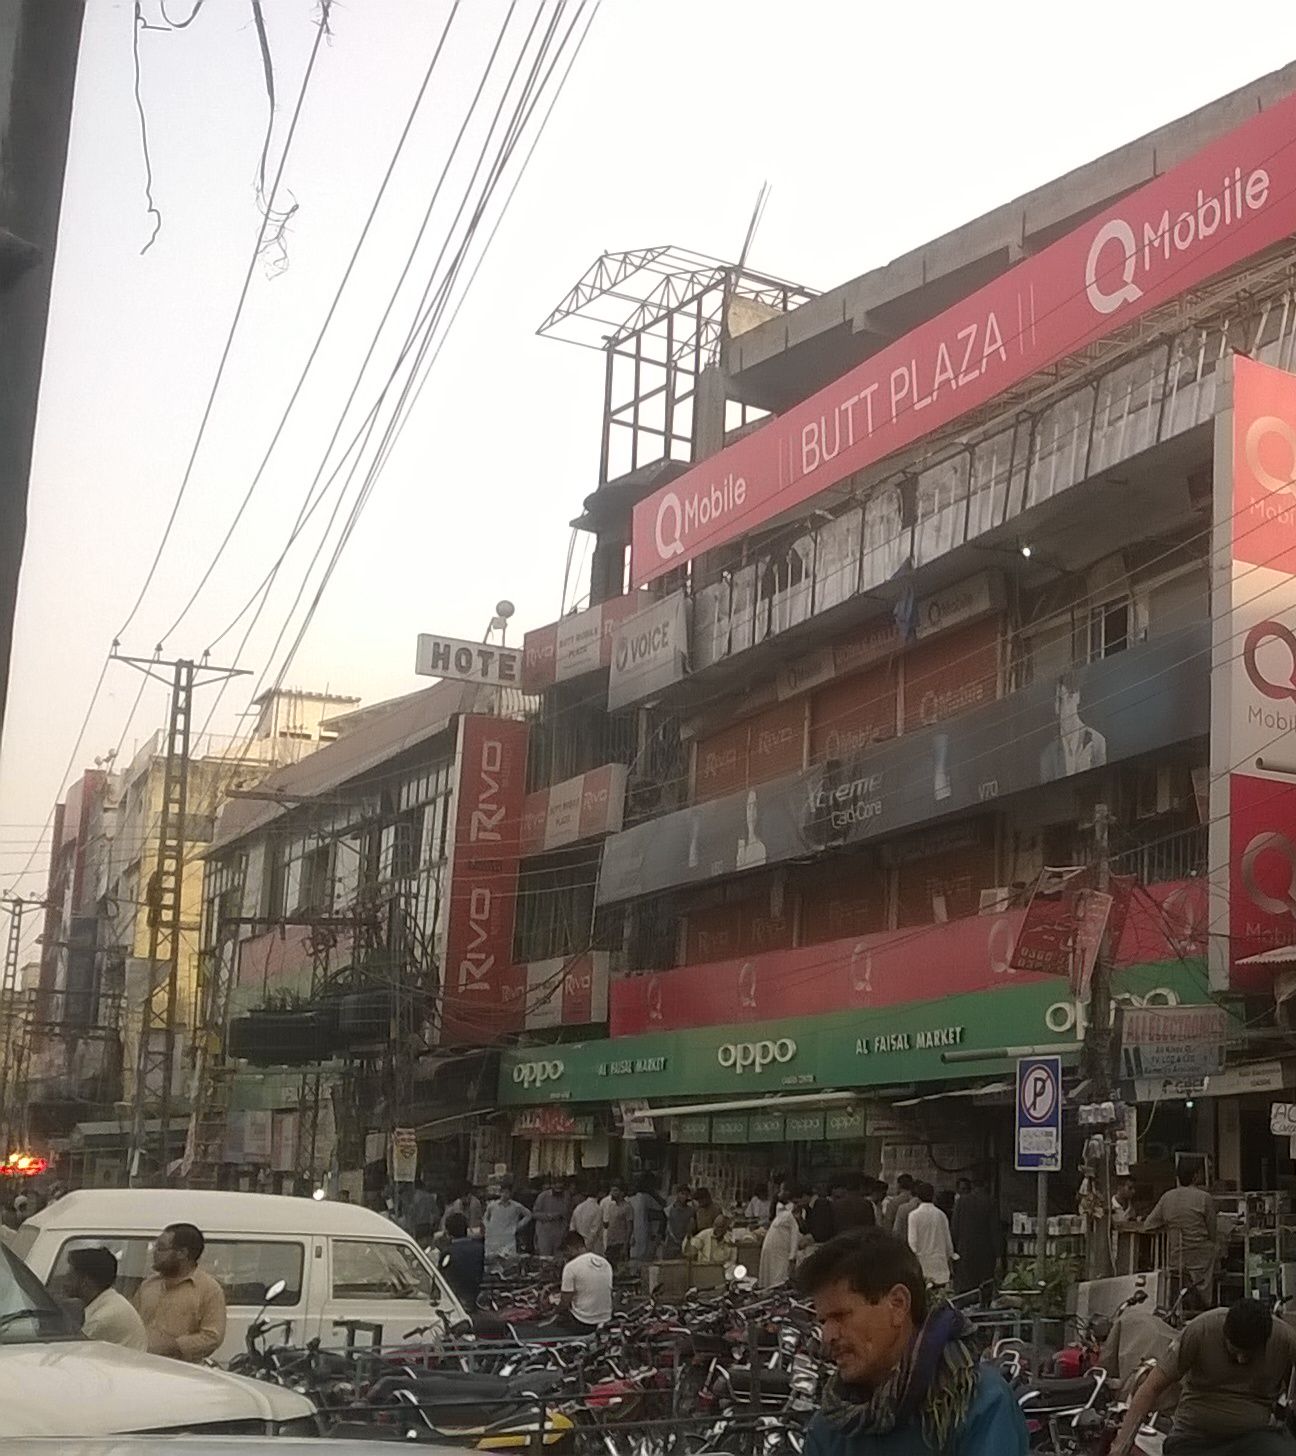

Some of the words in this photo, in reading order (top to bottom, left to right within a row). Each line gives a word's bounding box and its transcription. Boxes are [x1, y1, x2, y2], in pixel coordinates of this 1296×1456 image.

[800, 381, 880, 475] BUTT
[889, 311, 1008, 430] PLAZA
[430, 641, 516, 681] HOTE
[631, 621, 669, 662] VOICE
[470, 741, 506, 841] RIVO
[458, 889, 495, 992] RIVO
[718, 1038, 797, 1074] oppo
[856, 1038, 870, 1055] AL
[874, 1033, 910, 1053] FAISAL
[916, 1026, 965, 1050] MARKET
[513, 1060, 565, 1089] oppo
